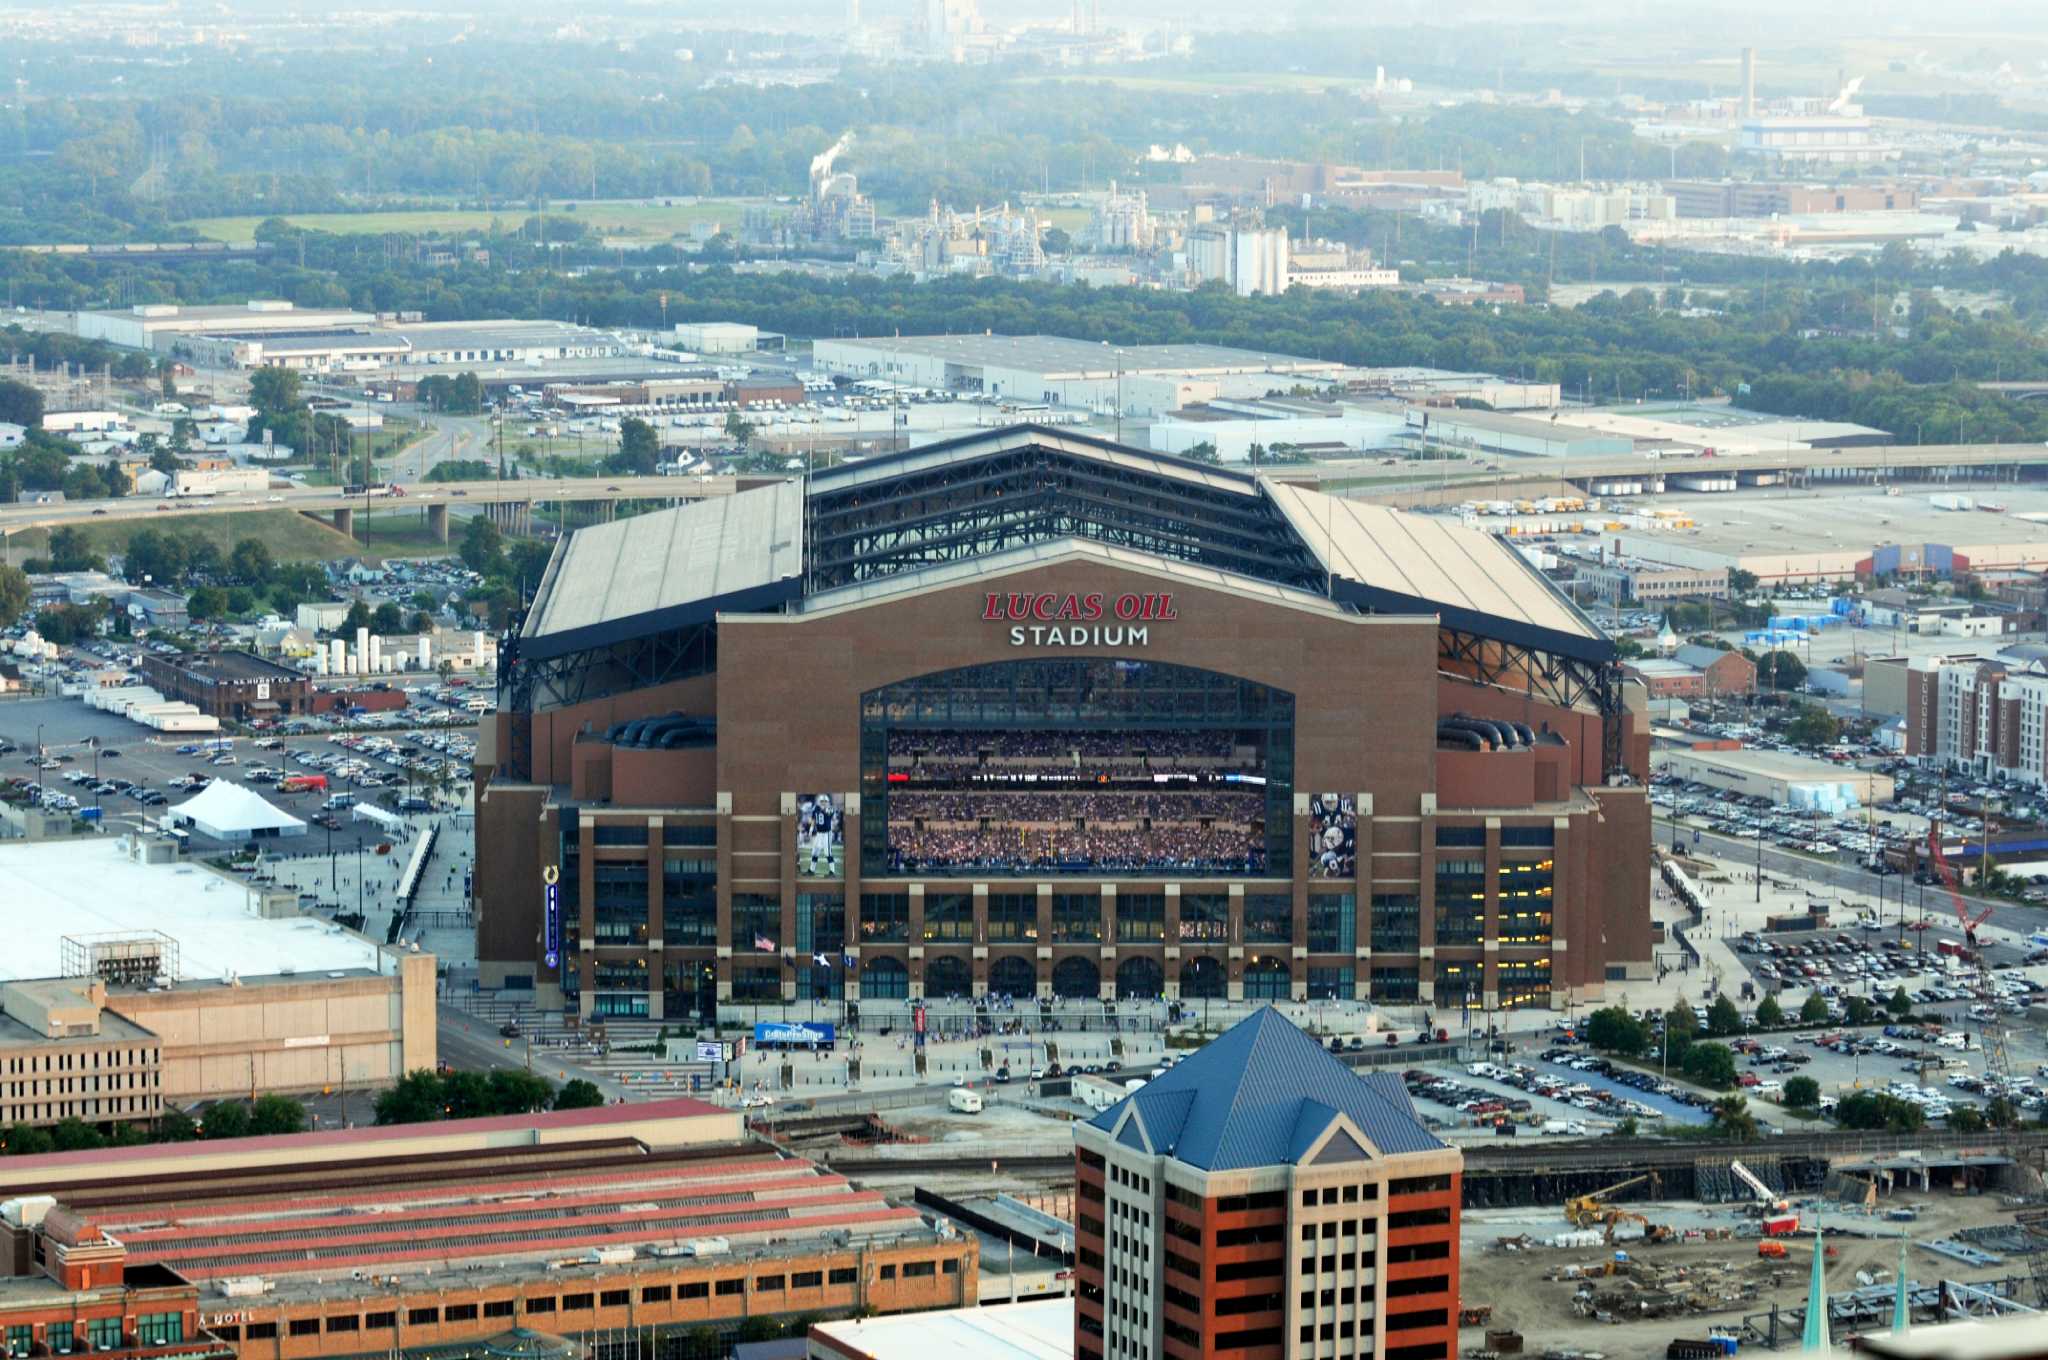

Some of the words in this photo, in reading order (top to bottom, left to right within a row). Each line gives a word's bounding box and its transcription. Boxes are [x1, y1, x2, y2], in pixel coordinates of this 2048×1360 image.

[983, 592, 1103, 620] LUCAS
[1115, 592, 1177, 620] OIL
[1010, 625, 1148, 645] STADIUM
[214, 1311, 256, 1325] HOTEL
